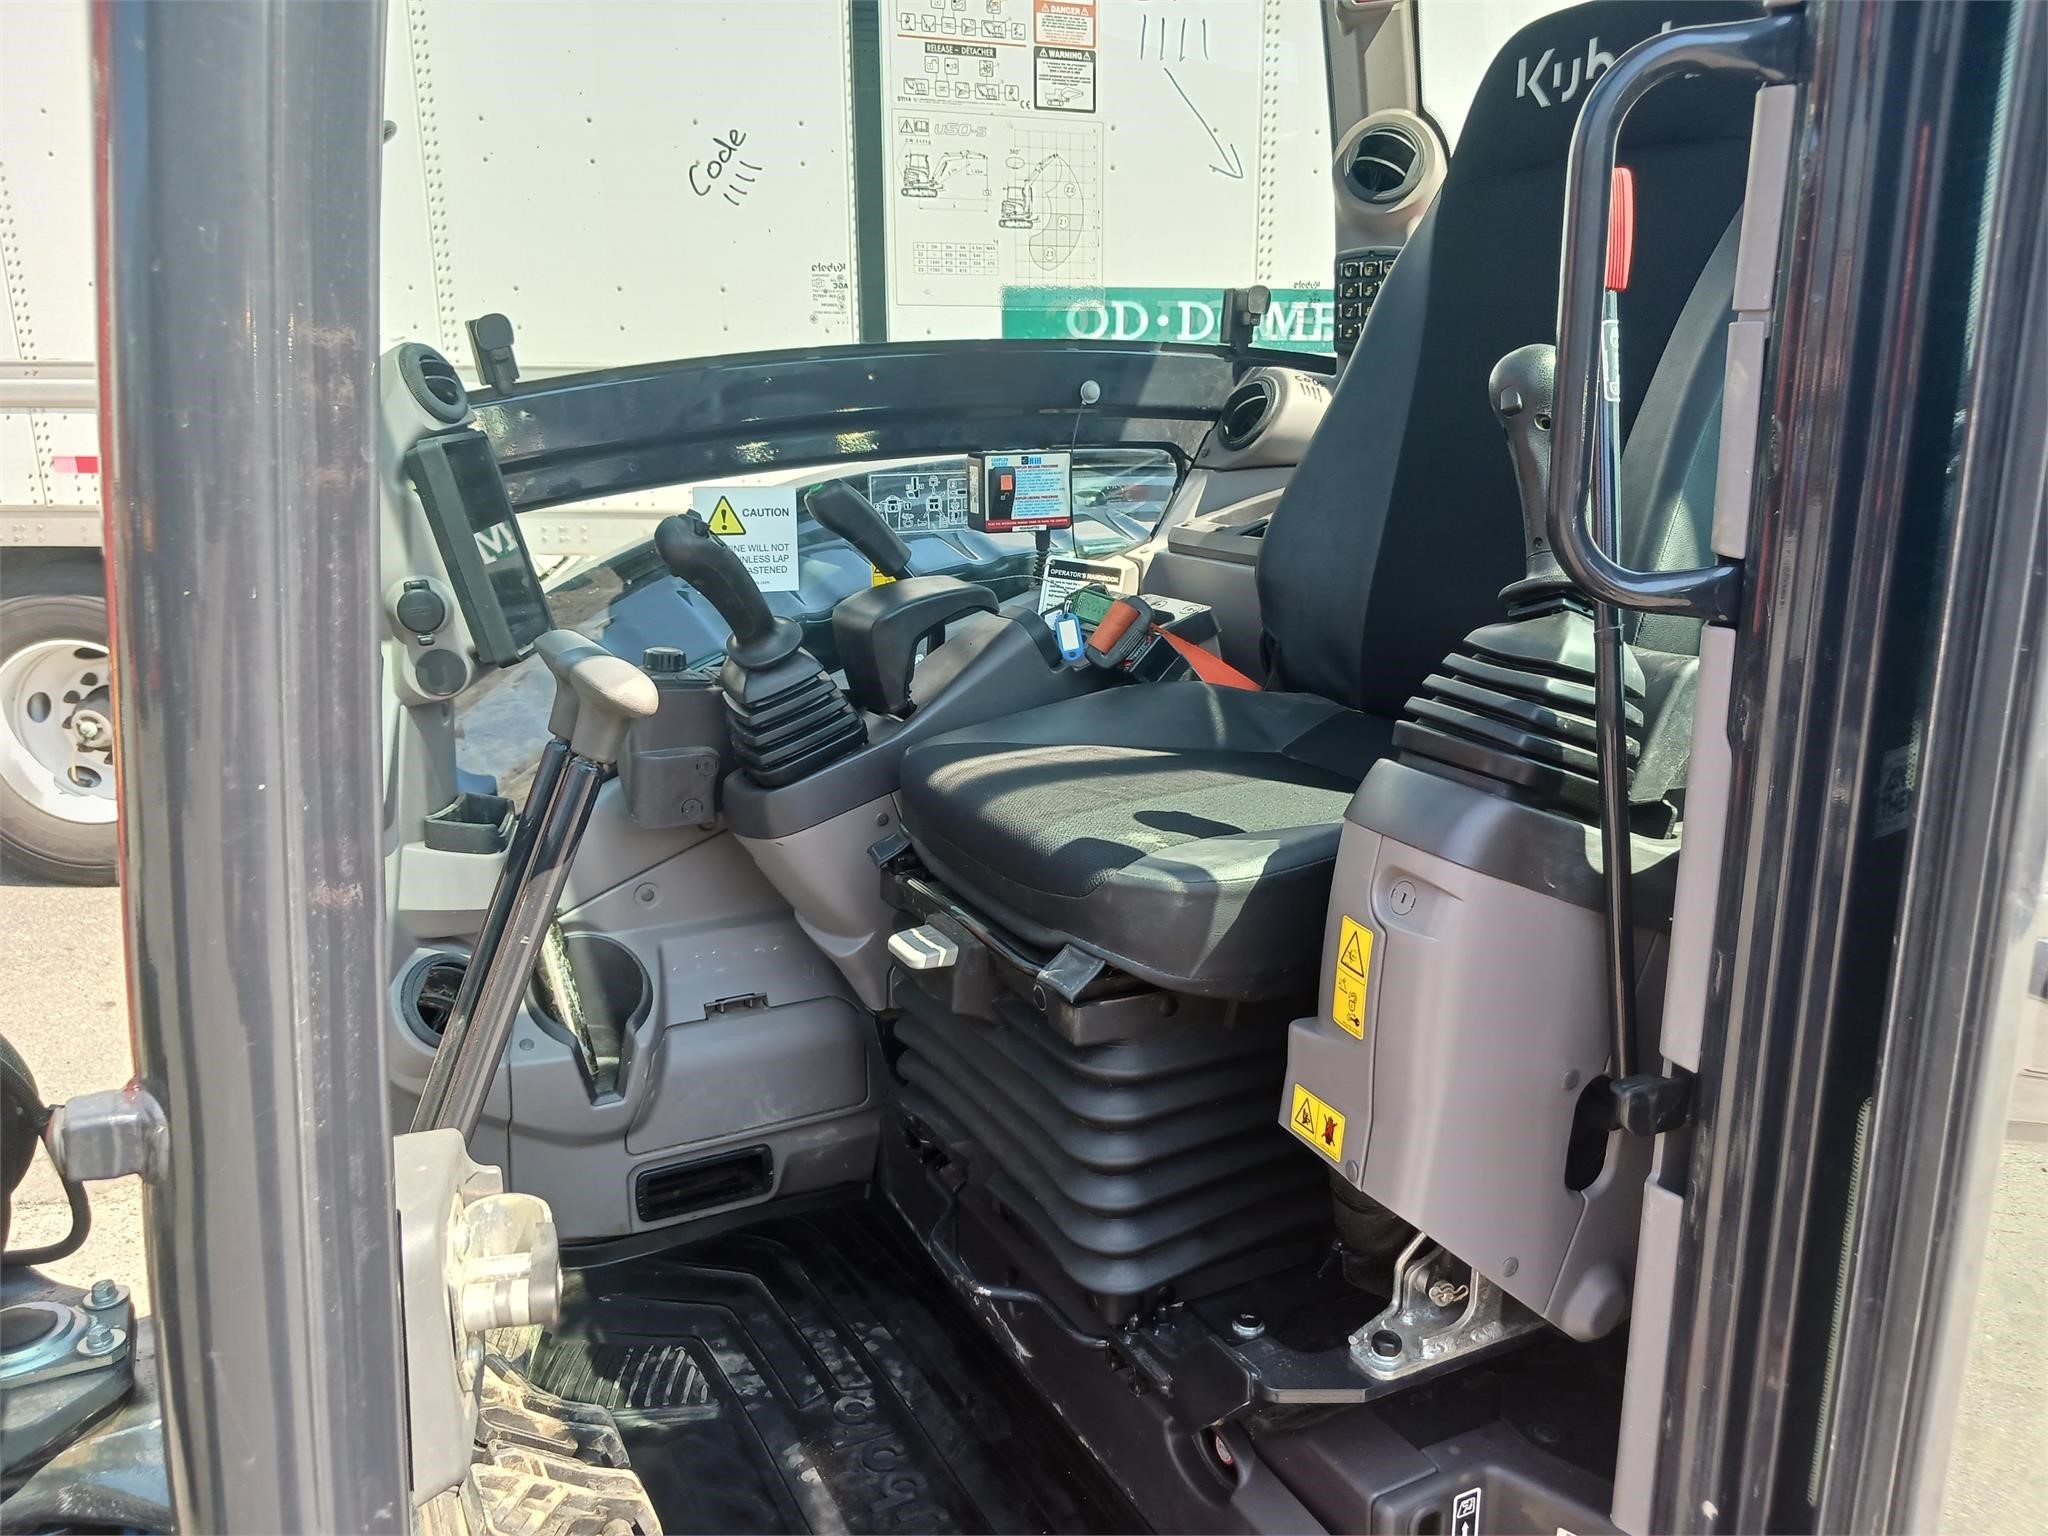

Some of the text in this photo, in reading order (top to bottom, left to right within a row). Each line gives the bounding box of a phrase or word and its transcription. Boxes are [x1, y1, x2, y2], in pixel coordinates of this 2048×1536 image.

[1051, 5, 1080, 15] DANGER
[926, 44, 953, 54] RELEASE
[1049, 49, 1082, 60] WARNING
[689, 129, 746, 196] Code
[742, 508, 789, 517] CAUTION
[748, 544, 769, 552] WILL
[771, 543, 789, 552] NOT
[740, 554, 789, 563] NLESS LAP
[747, 565, 787, 574] ASTENED
[1050, 568, 1120, 582] OPERATOR'S HANDBOOK
